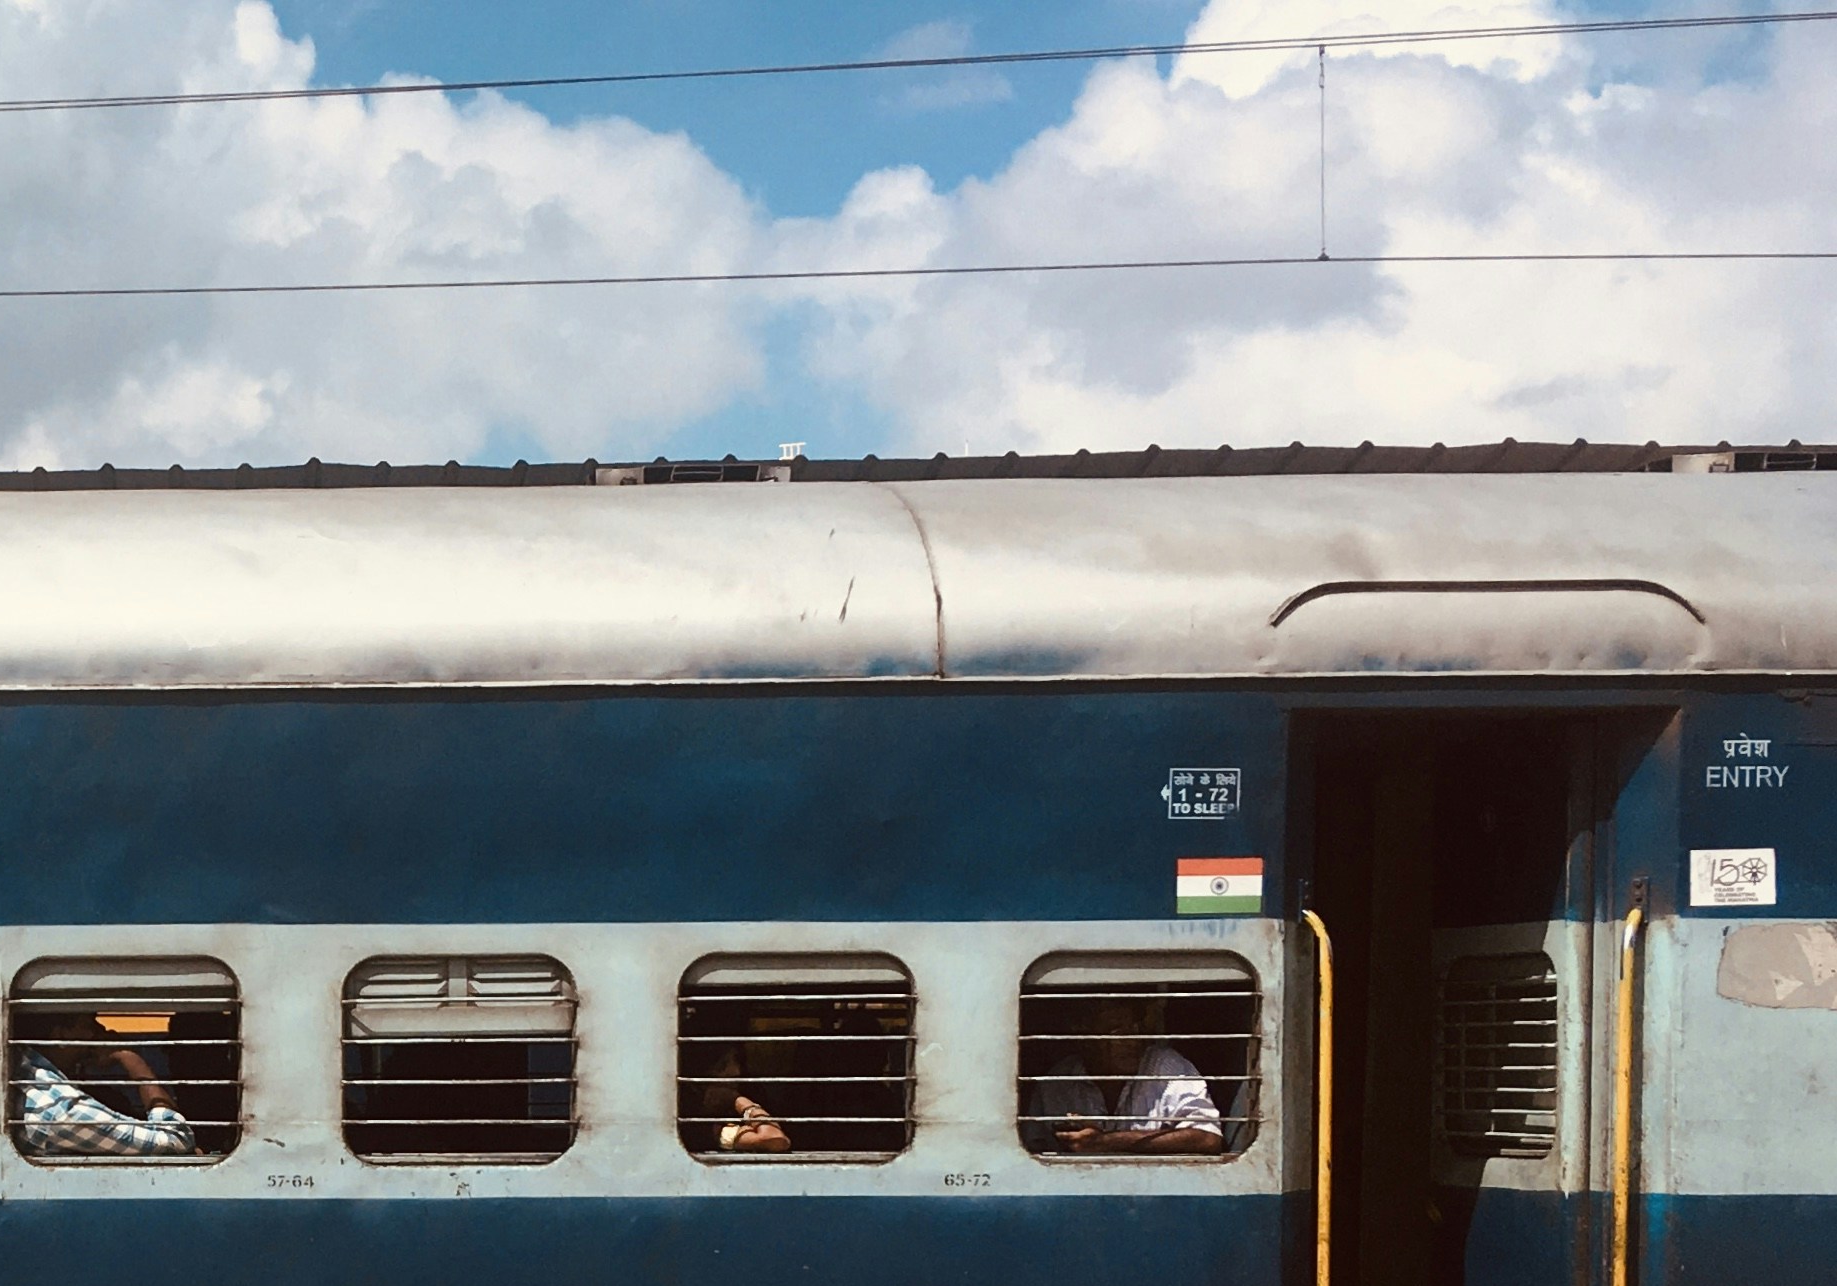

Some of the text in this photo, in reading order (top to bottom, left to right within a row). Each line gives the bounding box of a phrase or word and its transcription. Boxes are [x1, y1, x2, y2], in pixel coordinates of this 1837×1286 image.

[1722, 732, 1772, 759] प्रवेश
[1705, 765, 1790, 788] ENTRY
[1177, 787, 1187, 802] 1
[1208, 787, 1229, 802] 72
[1172, 803, 1192, 815] TO
